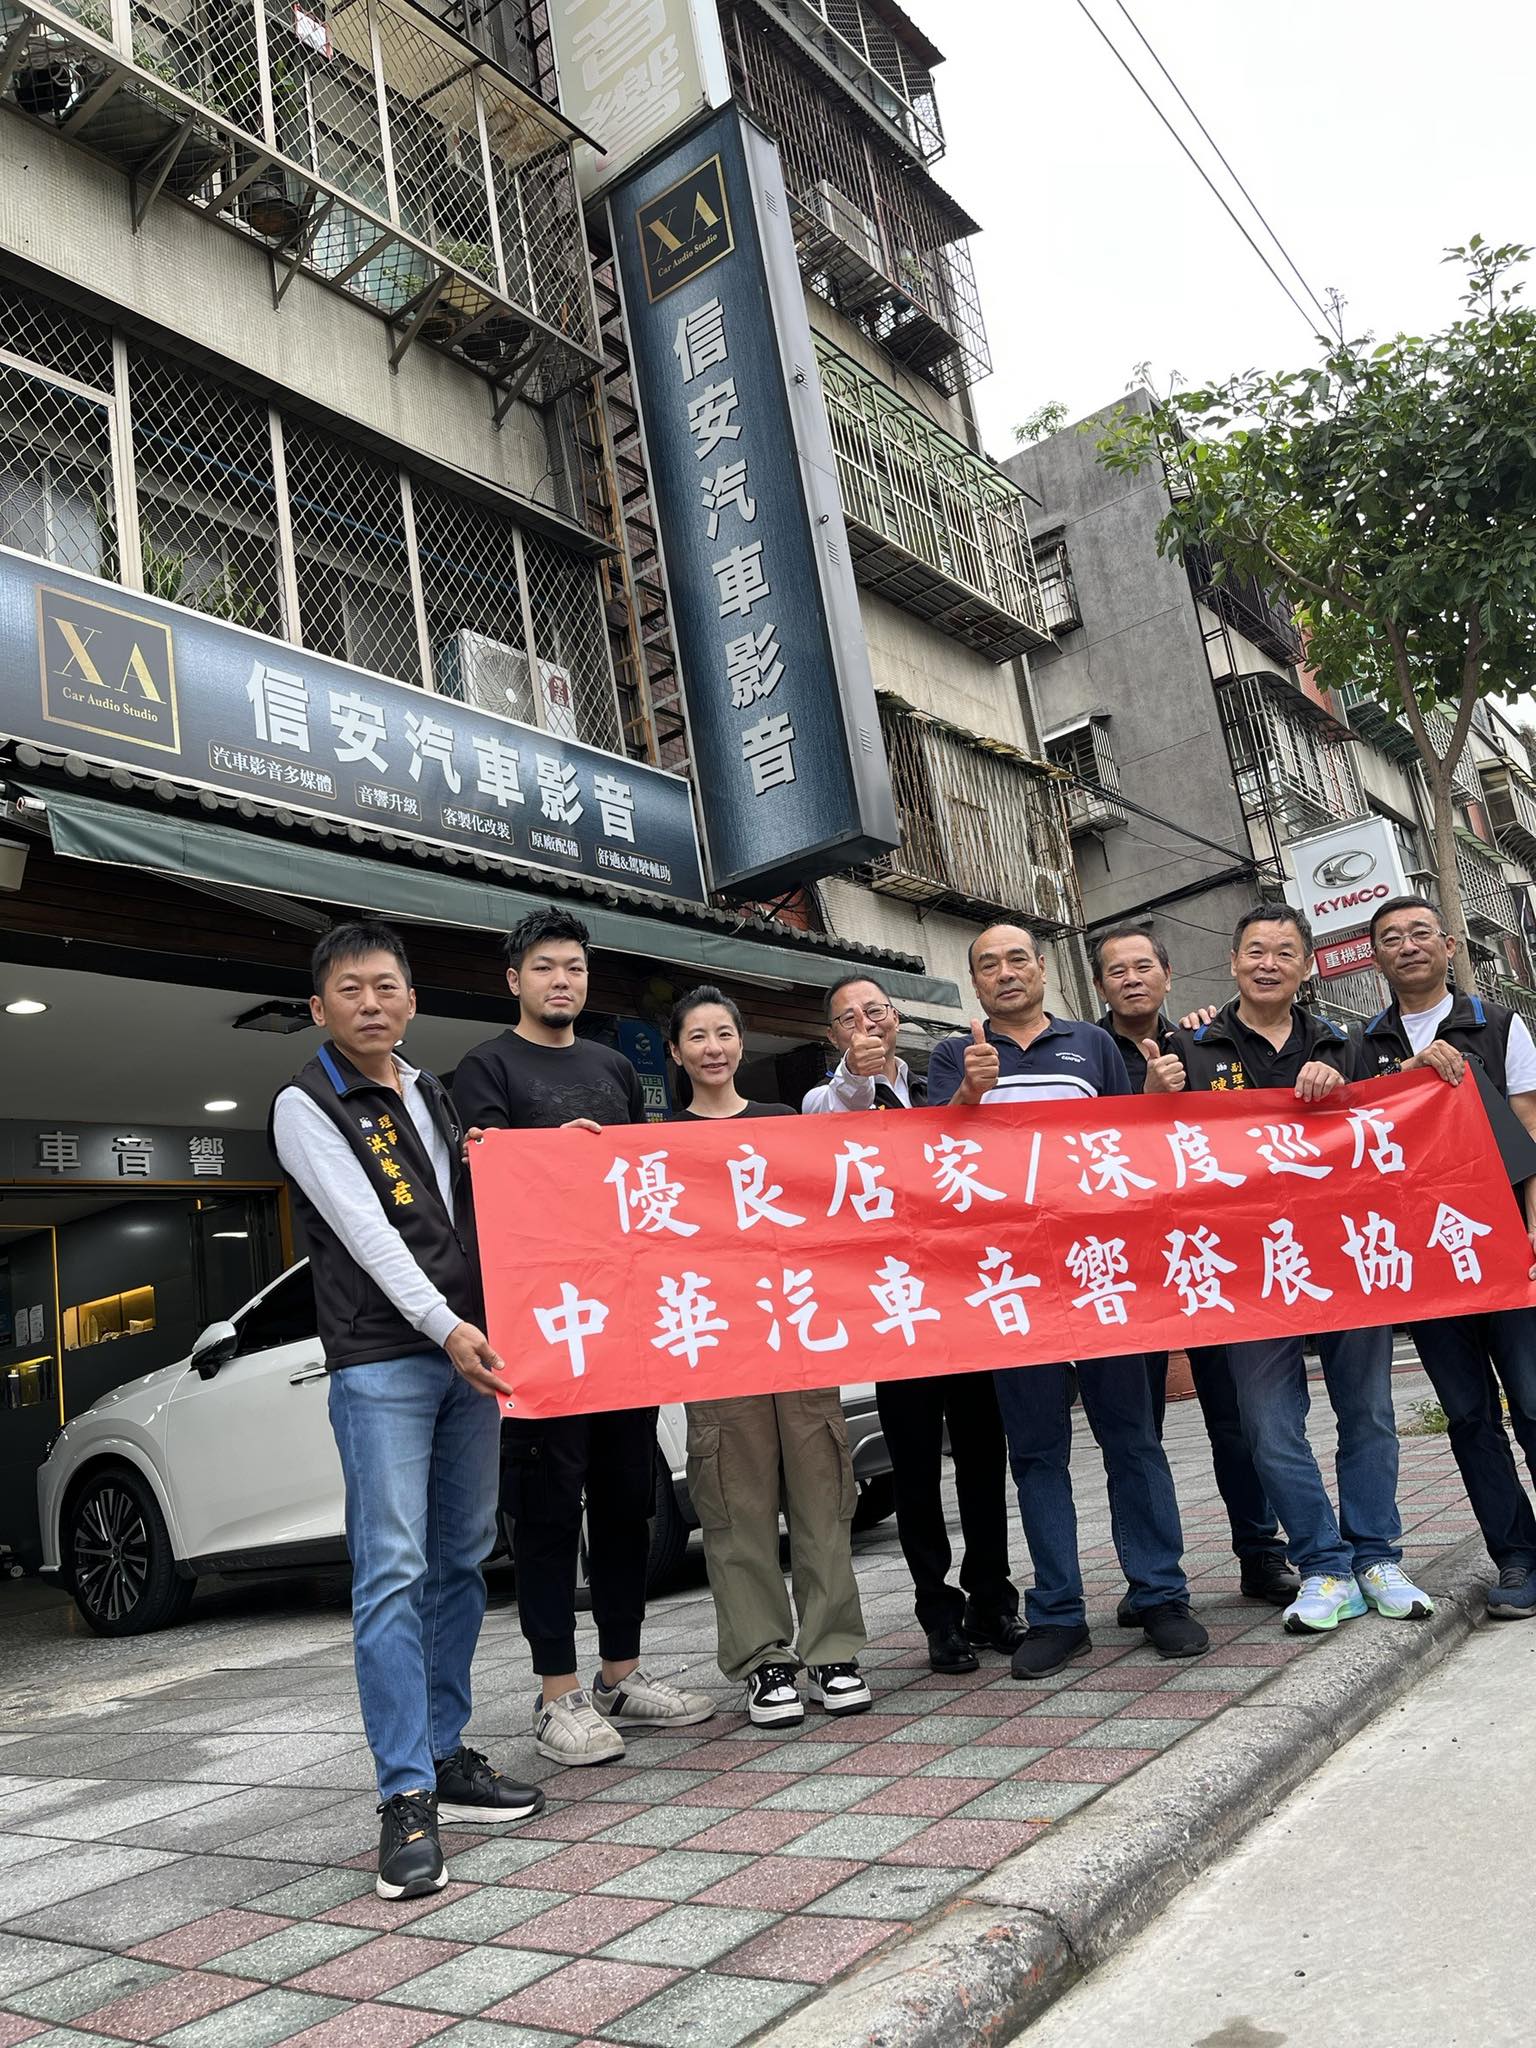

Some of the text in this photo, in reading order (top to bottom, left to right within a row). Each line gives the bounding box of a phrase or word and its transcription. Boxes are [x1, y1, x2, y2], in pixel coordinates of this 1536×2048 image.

[659, 234, 718, 277] Car Audio Studio
[673, 297, 796, 796] 信安汽車影音
[62, 686, 158, 722] Car Audio Studio
[212, 745, 334, 794] 汽車影音多媒體
[246, 660, 636, 844] 信安汽車影音
[358, 785, 420, 817] 音響升級
[442, 806, 511, 842] 客製化改裝
[531, 829, 580, 859] 原廠配備
[1313, 884, 1390, 917] KYMCO
[39, 1131, 225, 1176] 車音響
[603, 1108, 1406, 1238] 優良店家/深度巡店
[533, 1202, 1493, 1378] 中華汽車音響發展協會
